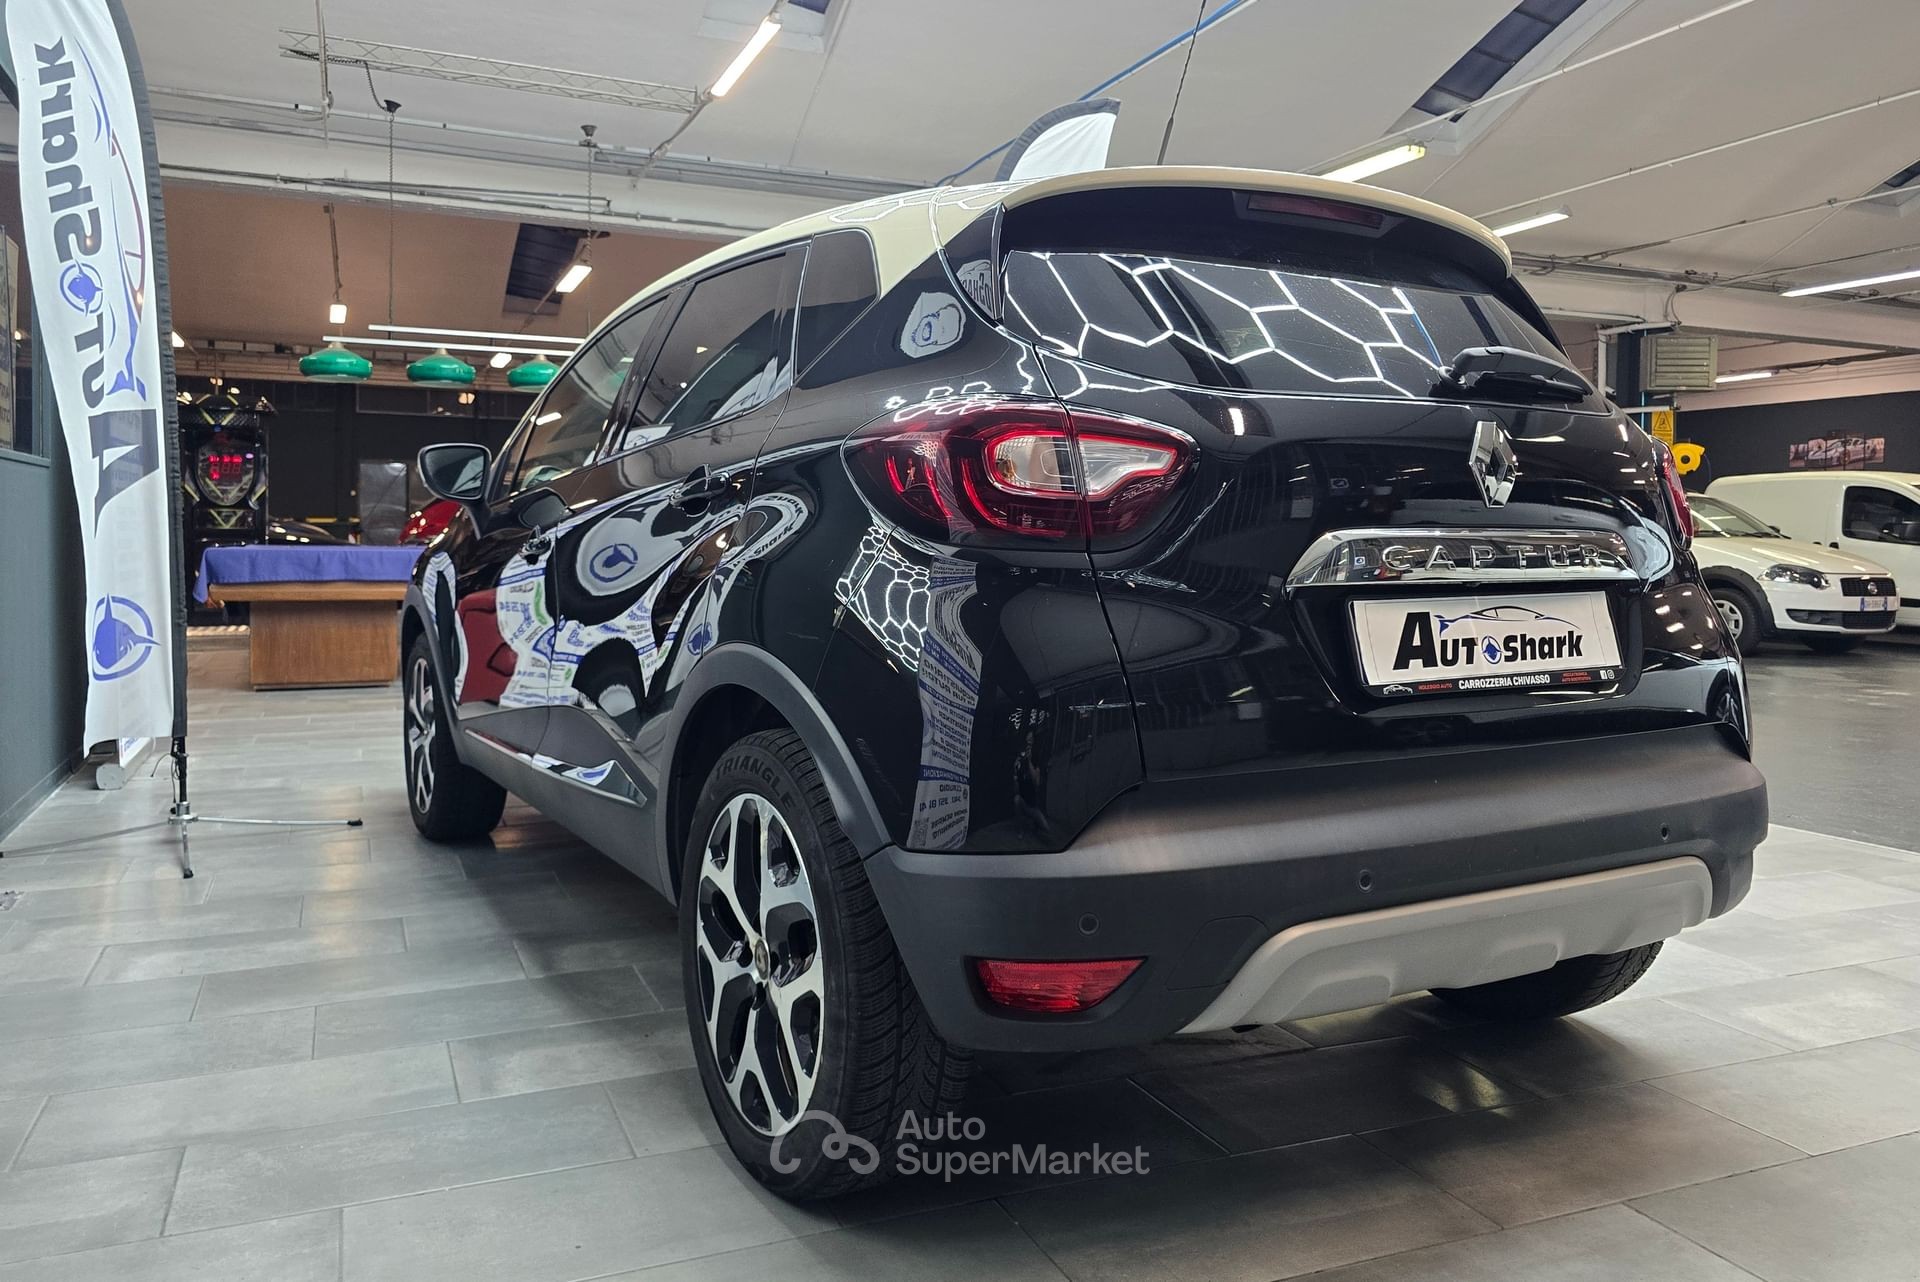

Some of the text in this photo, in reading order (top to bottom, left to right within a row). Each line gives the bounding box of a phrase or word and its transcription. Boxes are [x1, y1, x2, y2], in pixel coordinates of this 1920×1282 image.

[1381, 544, 1602, 572] CAPTUR
[1458, 673, 1551, 690] CARROZZERIA CHIVASSO
[716, 755, 796, 813] TRIANGLE
